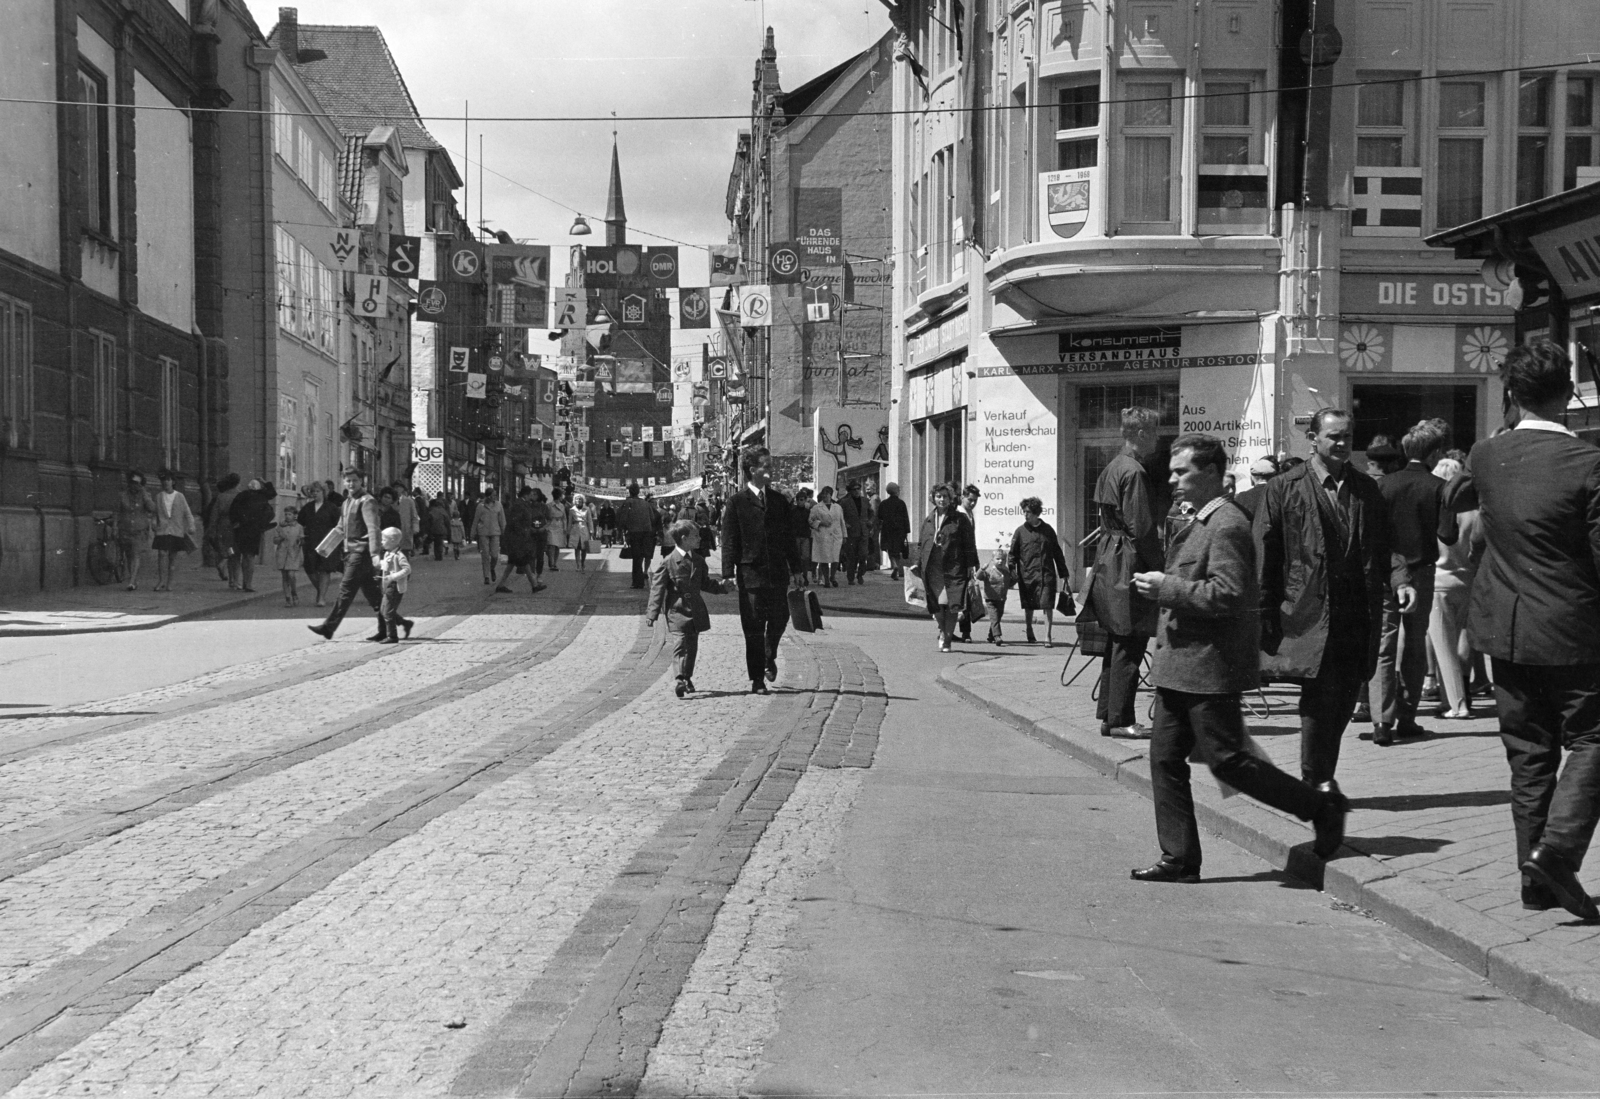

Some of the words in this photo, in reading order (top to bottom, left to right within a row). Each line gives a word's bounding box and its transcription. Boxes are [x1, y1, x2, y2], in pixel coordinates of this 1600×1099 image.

[1077, 171, 1090, 179] 1968
[809, 228, 832, 237] DAS
[807, 246, 833, 255] HAUS
[826, 255, 836, 263] IN
[1558, 234, 1600, 283] AU
[652, 262, 673, 271] DMR
[1379, 282, 1417, 304] DIE
[1433, 283, 1510, 306] OSTS
[1070, 332, 1181, 347] konsument
[1059, 347, 1180, 362] VERSANDHAUS
[1123, 358, 1190, 370] AGENTUR
[1196, 354, 1267, 366] ROSTOCK
[984, 410, 1027, 421] Verkauf
[1182, 405, 1206, 415] Aus
[985, 426, 1056, 437] Musterschau
[1183, 420, 1212, 432] 2000
[1213, 420, 1261, 432] Artikeln
[985, 442, 1031, 453] Kunden-
[1228, 436, 1247, 448] Sie
[1249, 436, 1272, 447] hier
[984, 458, 1034, 471] beratung
[984, 474, 1035, 484] Annahme
[984, 492, 1004, 500] von
